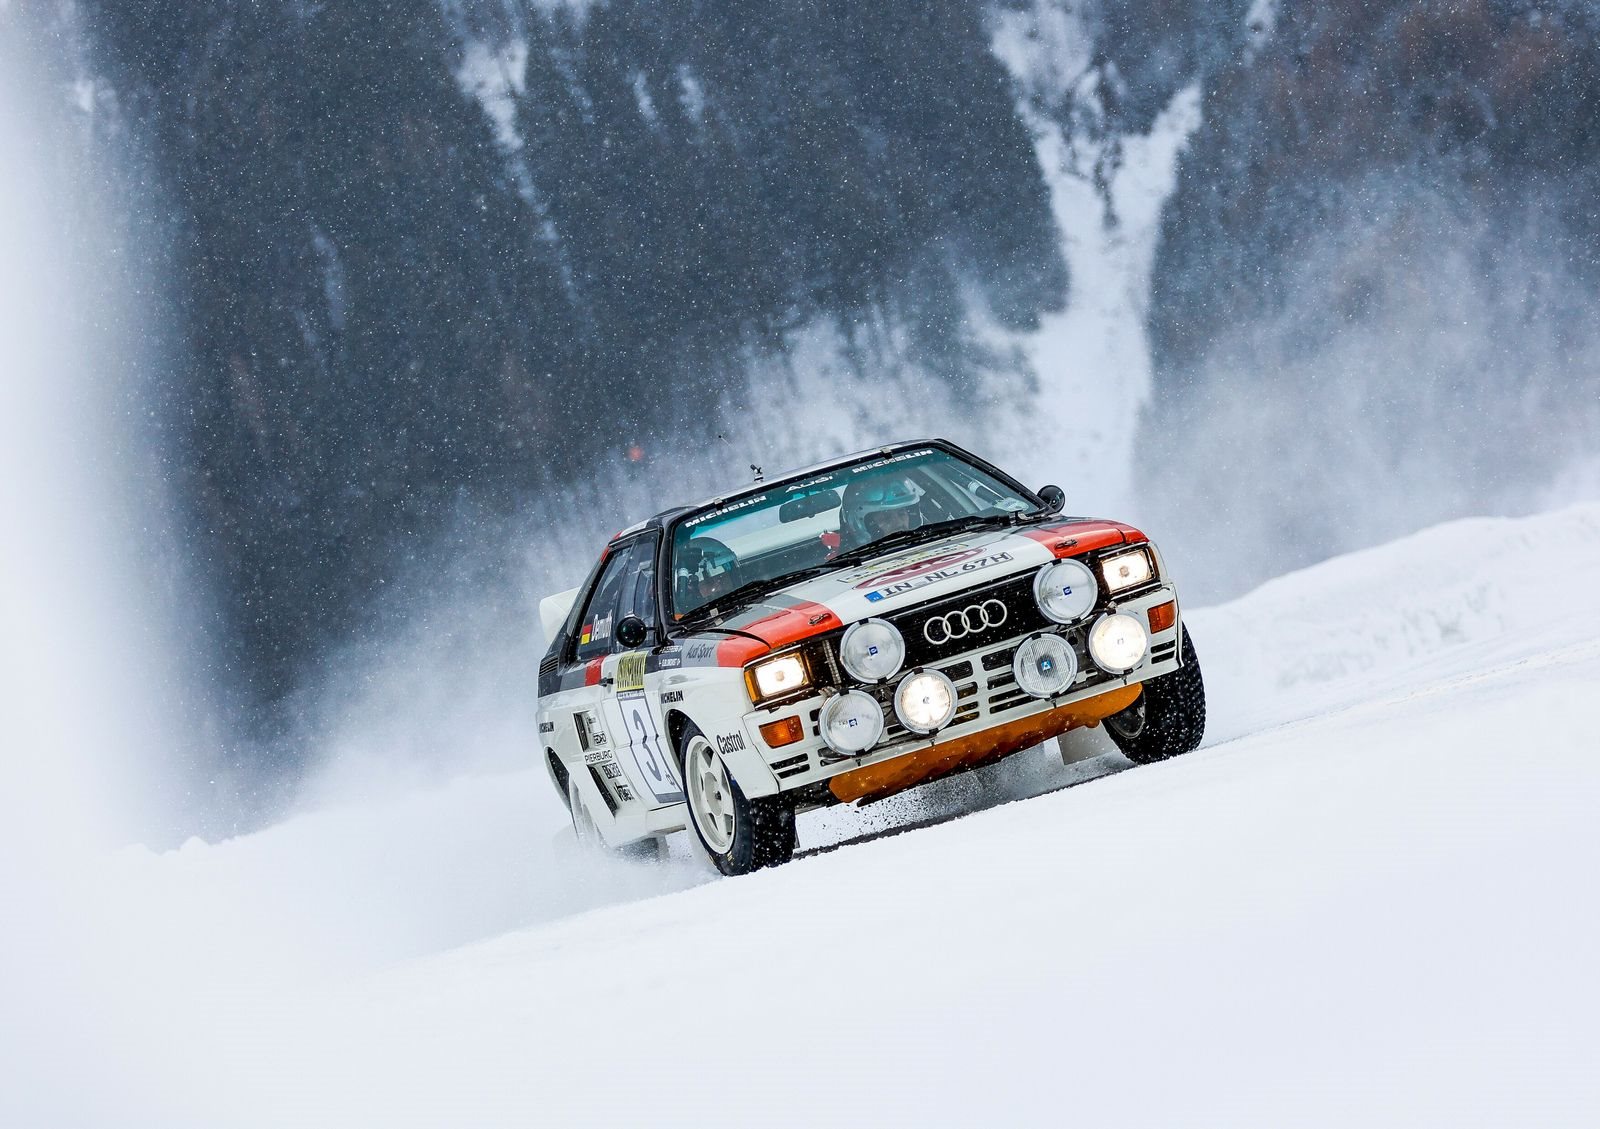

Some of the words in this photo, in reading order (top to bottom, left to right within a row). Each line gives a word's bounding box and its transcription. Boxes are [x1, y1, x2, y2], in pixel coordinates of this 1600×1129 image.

[685, 495, 767, 528] MICHELIN
[852, 449, 933, 475] MICHELIN
[884, 582, 912, 597] IN
[925, 569, 959, 583] NL
[962, 551, 1013, 572] 67H
[686, 644, 701, 659] Audi
[697, 643, 716, 662] Sport
[584, 750, 613, 763] PIERBURG
[632, 709, 662, 782] 3
[716, 730, 746, 755] Castrol
